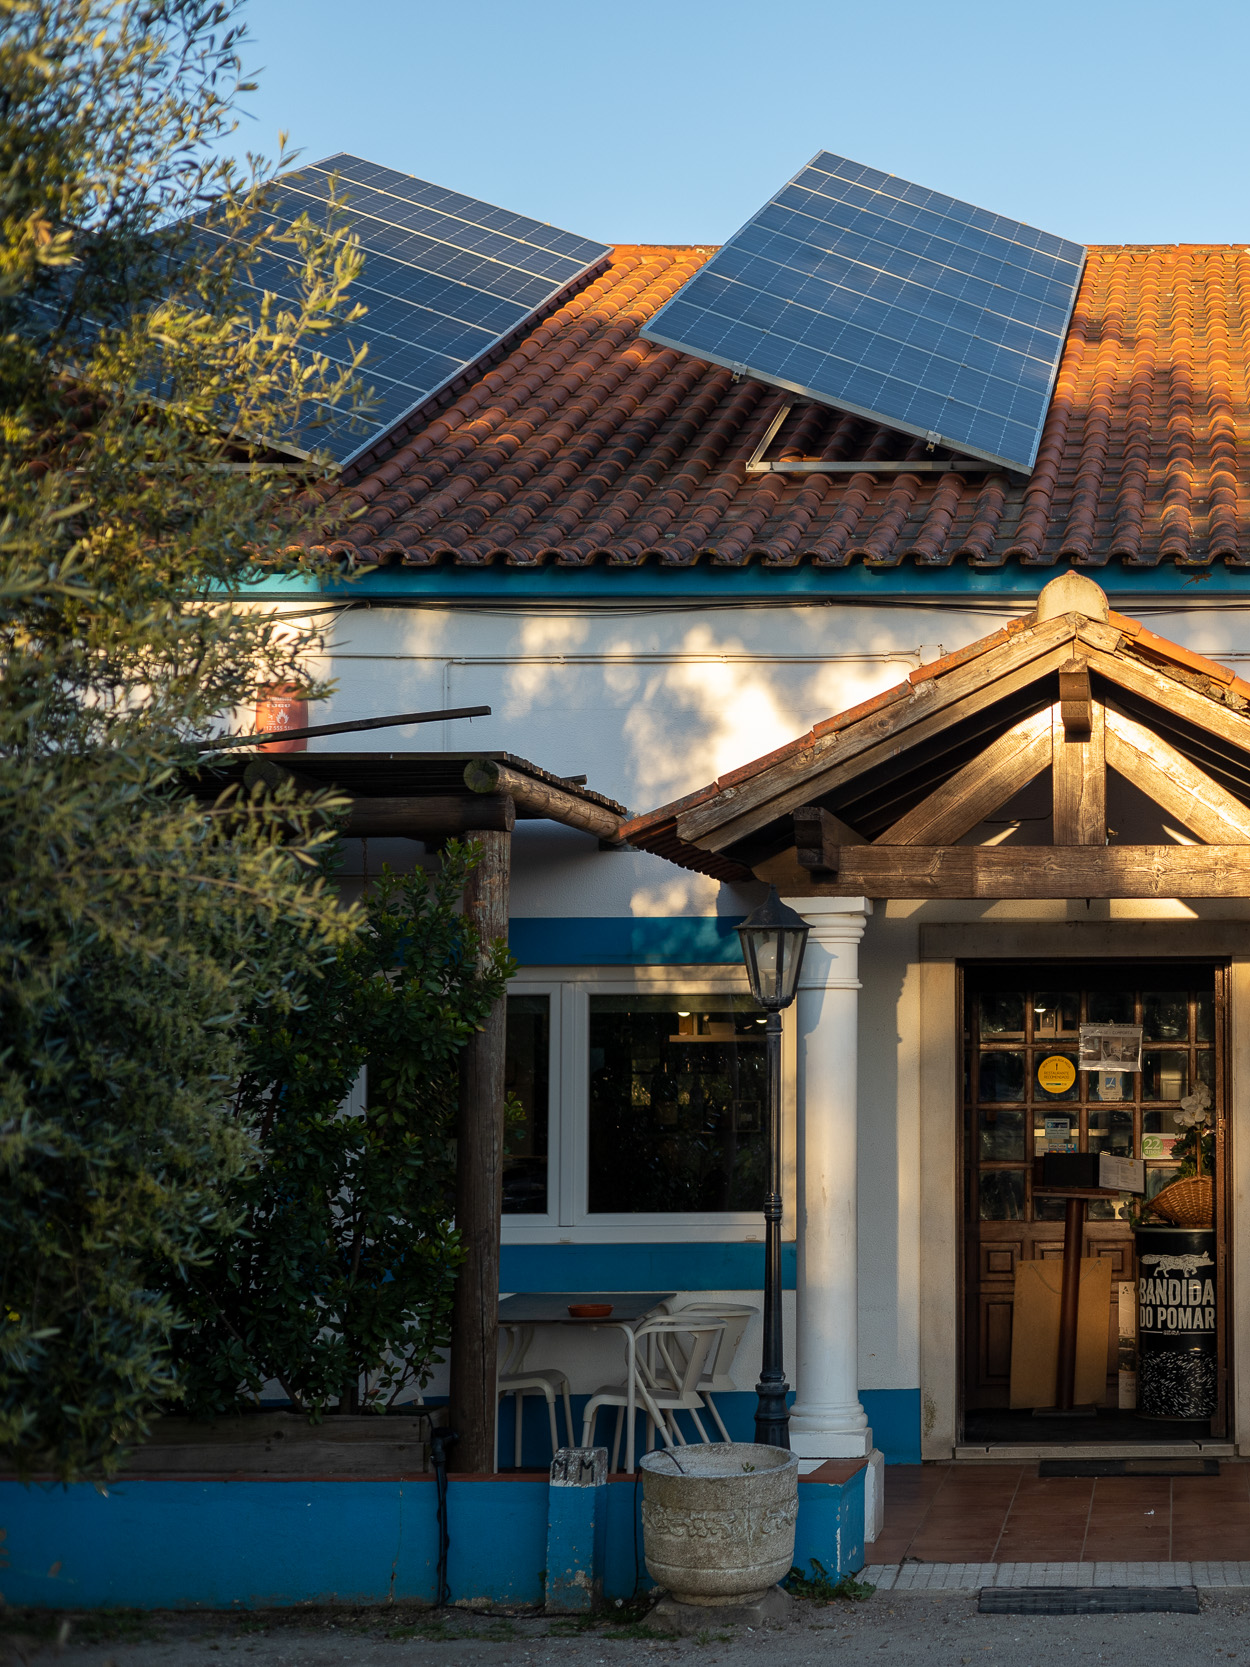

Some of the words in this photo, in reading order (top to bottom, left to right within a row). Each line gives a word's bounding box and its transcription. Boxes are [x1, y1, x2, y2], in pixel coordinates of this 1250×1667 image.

[1144, 1138, 1161, 1150] 22
[1139, 1277, 1215, 1306] BANDIDA
[1140, 1305, 1154, 1329] DO
[1157, 1306, 1215, 1330] POMAR
